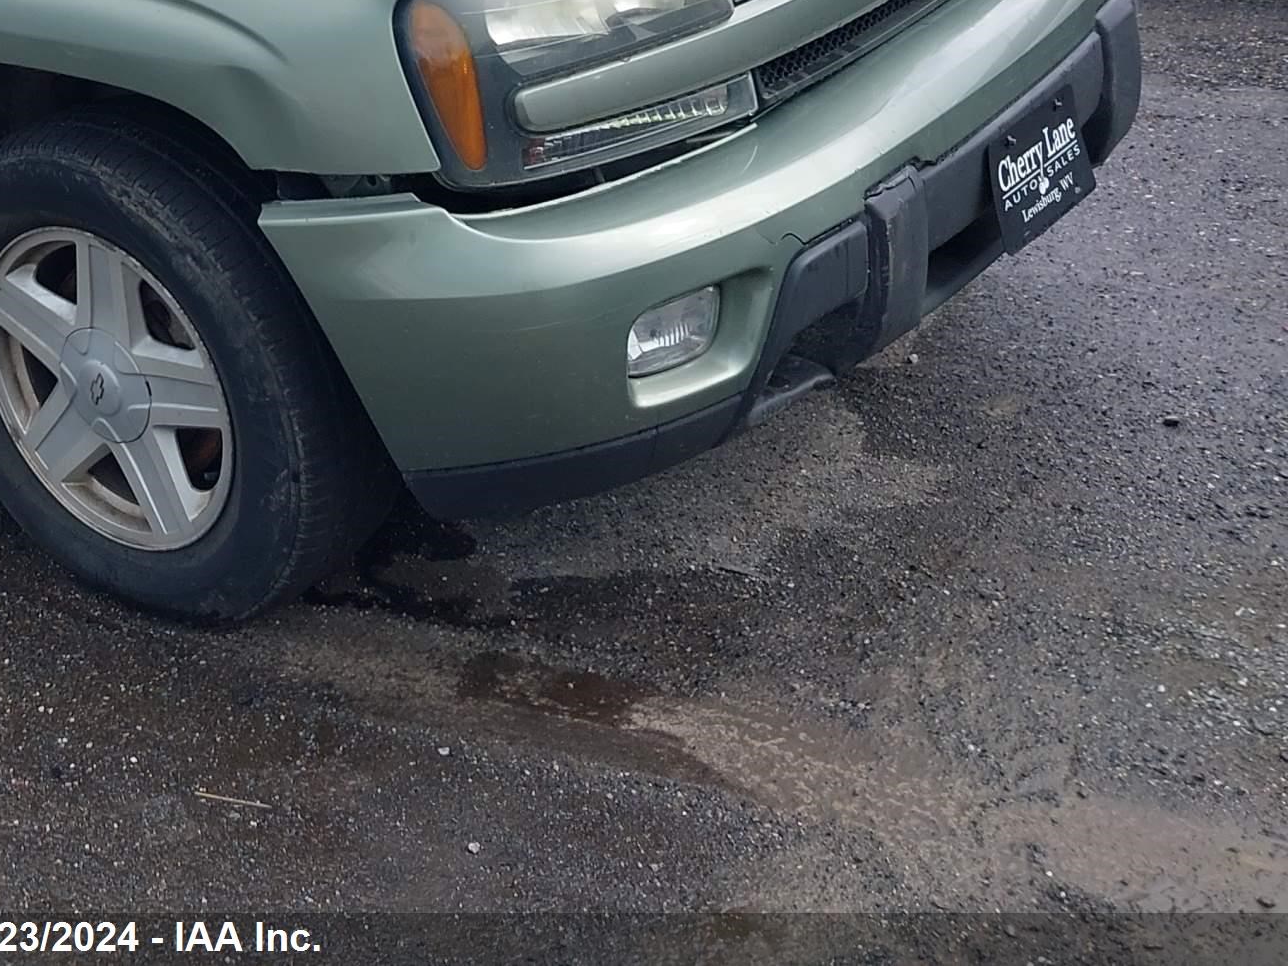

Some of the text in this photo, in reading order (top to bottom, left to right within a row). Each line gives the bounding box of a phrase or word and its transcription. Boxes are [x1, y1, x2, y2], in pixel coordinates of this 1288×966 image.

[998, 117, 1077, 192] Cherry Lane
[1004, 144, 1081, 212] AUTO SALES
[1059, 171, 1074, 191] WV
